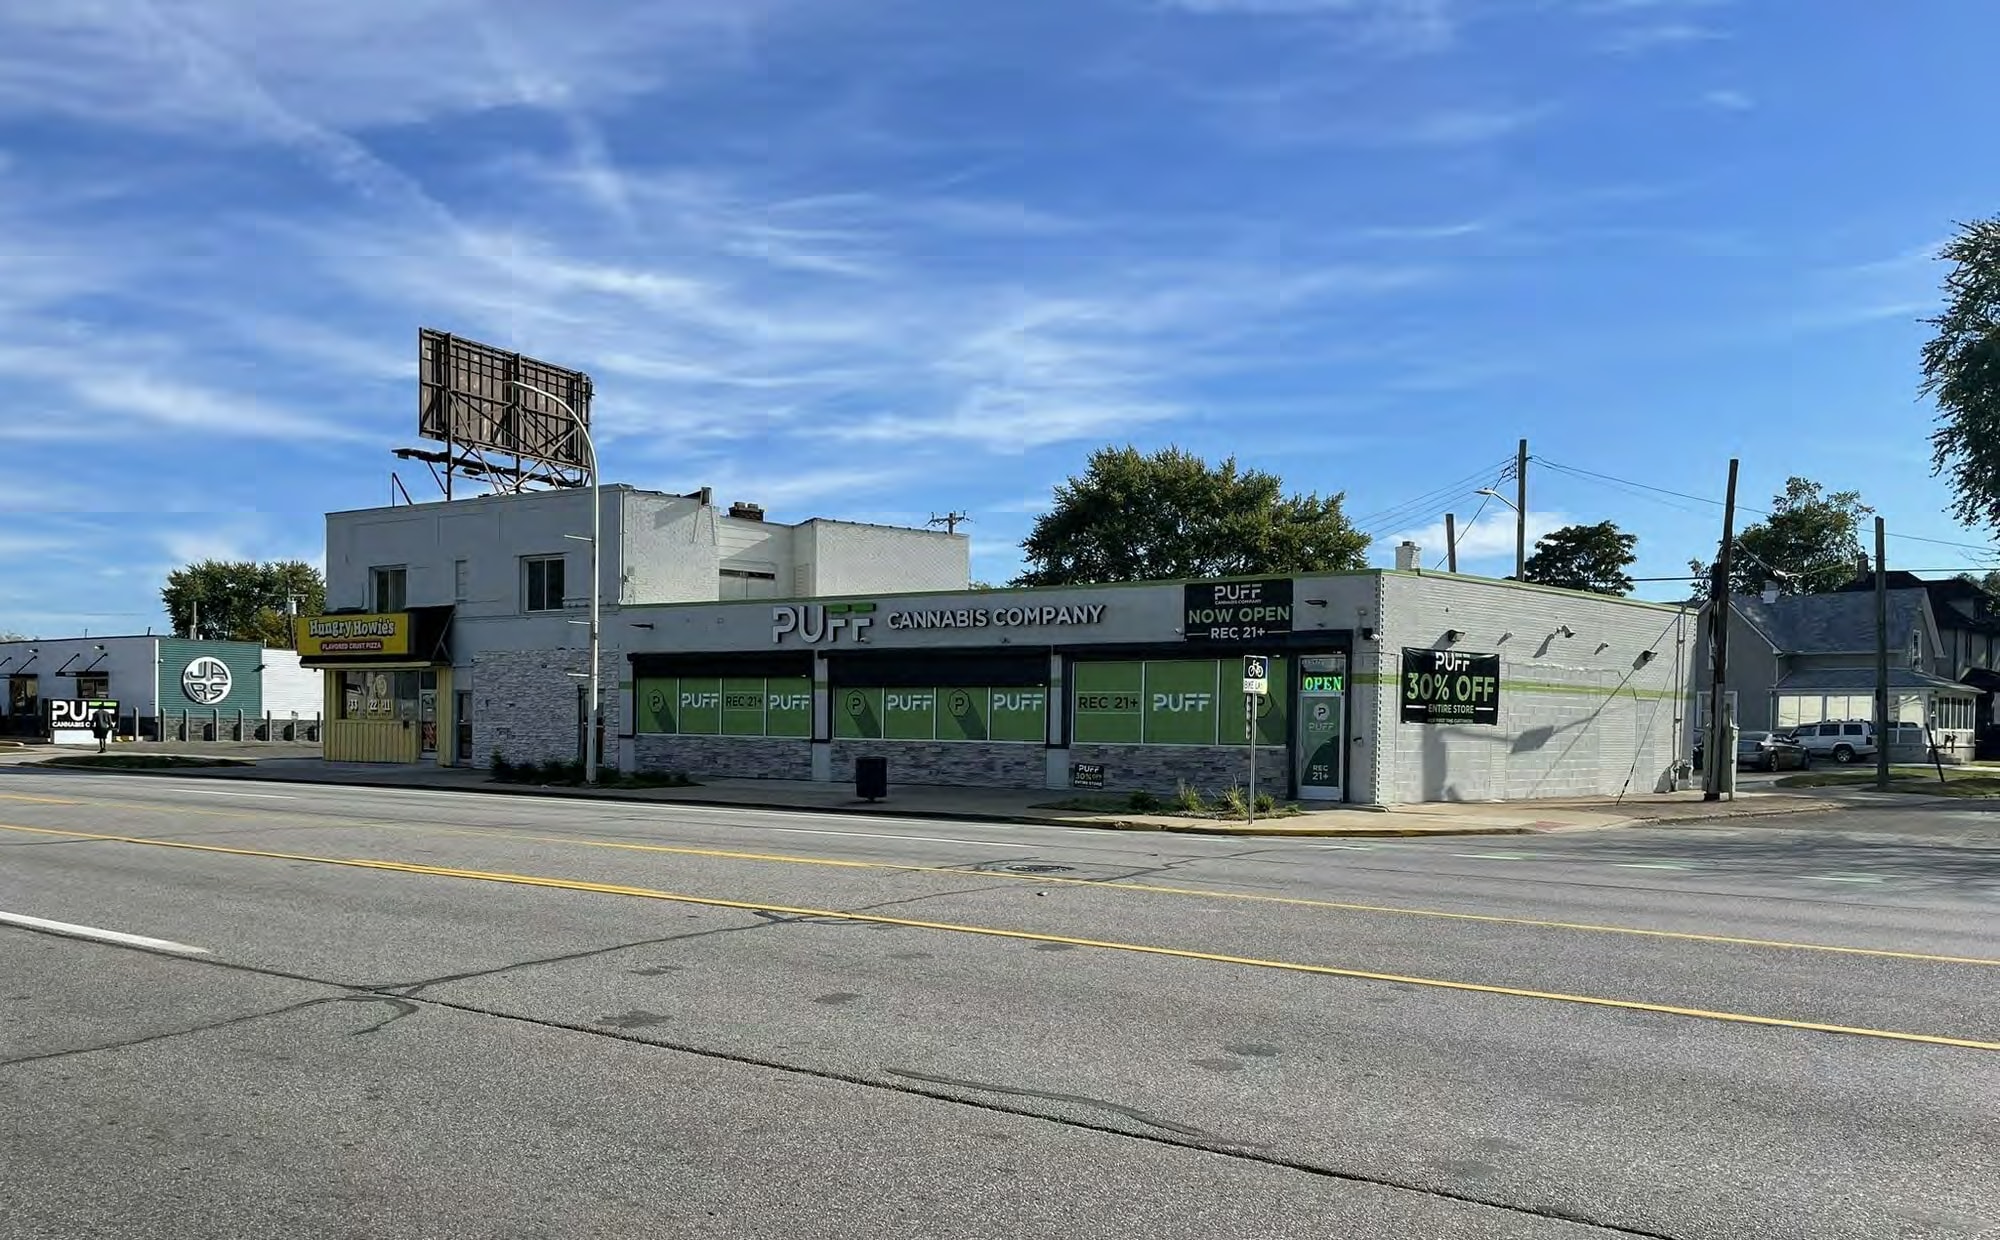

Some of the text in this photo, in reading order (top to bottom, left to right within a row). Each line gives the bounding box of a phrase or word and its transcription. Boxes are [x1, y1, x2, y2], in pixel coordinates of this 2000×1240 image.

[1214, 584, 1262, 600] PUFF
[1188, 606, 1290, 624] NOW OPEN
[309, 617, 397, 638] Hungry Howie's
[772, 603, 1106, 643] PUFF CANNABIS COMPANY
[1211, 626, 1266, 639] REC 21+
[321, 642, 349, 650] FLAVORED
[366, 641, 382, 649] PIZZA
[1435, 652, 1470, 672] PUFF
[1244, 680, 1254, 690] BIKE
[1304, 676, 1343, 691] OPEN
[1407, 672, 1495, 702] 30% OFF
[681, 693, 719, 709] PUFF
[726, 696, 763, 707] REC 21+
[770, 695, 811, 710] PUFF
[887, 694, 933, 711] PUFF
[993, 693, 1044, 711] PUFF
[1079, 696, 1138, 709] REC 21+
[1153, 693, 1211, 712] PUFF
[1428, 704, 1474, 714] ENTIRE STORE
[1308, 722, 1335, 730] PUFF
[1079, 764, 1100, 773] PUFF
[1312, 772, 1329, 780] 21+
